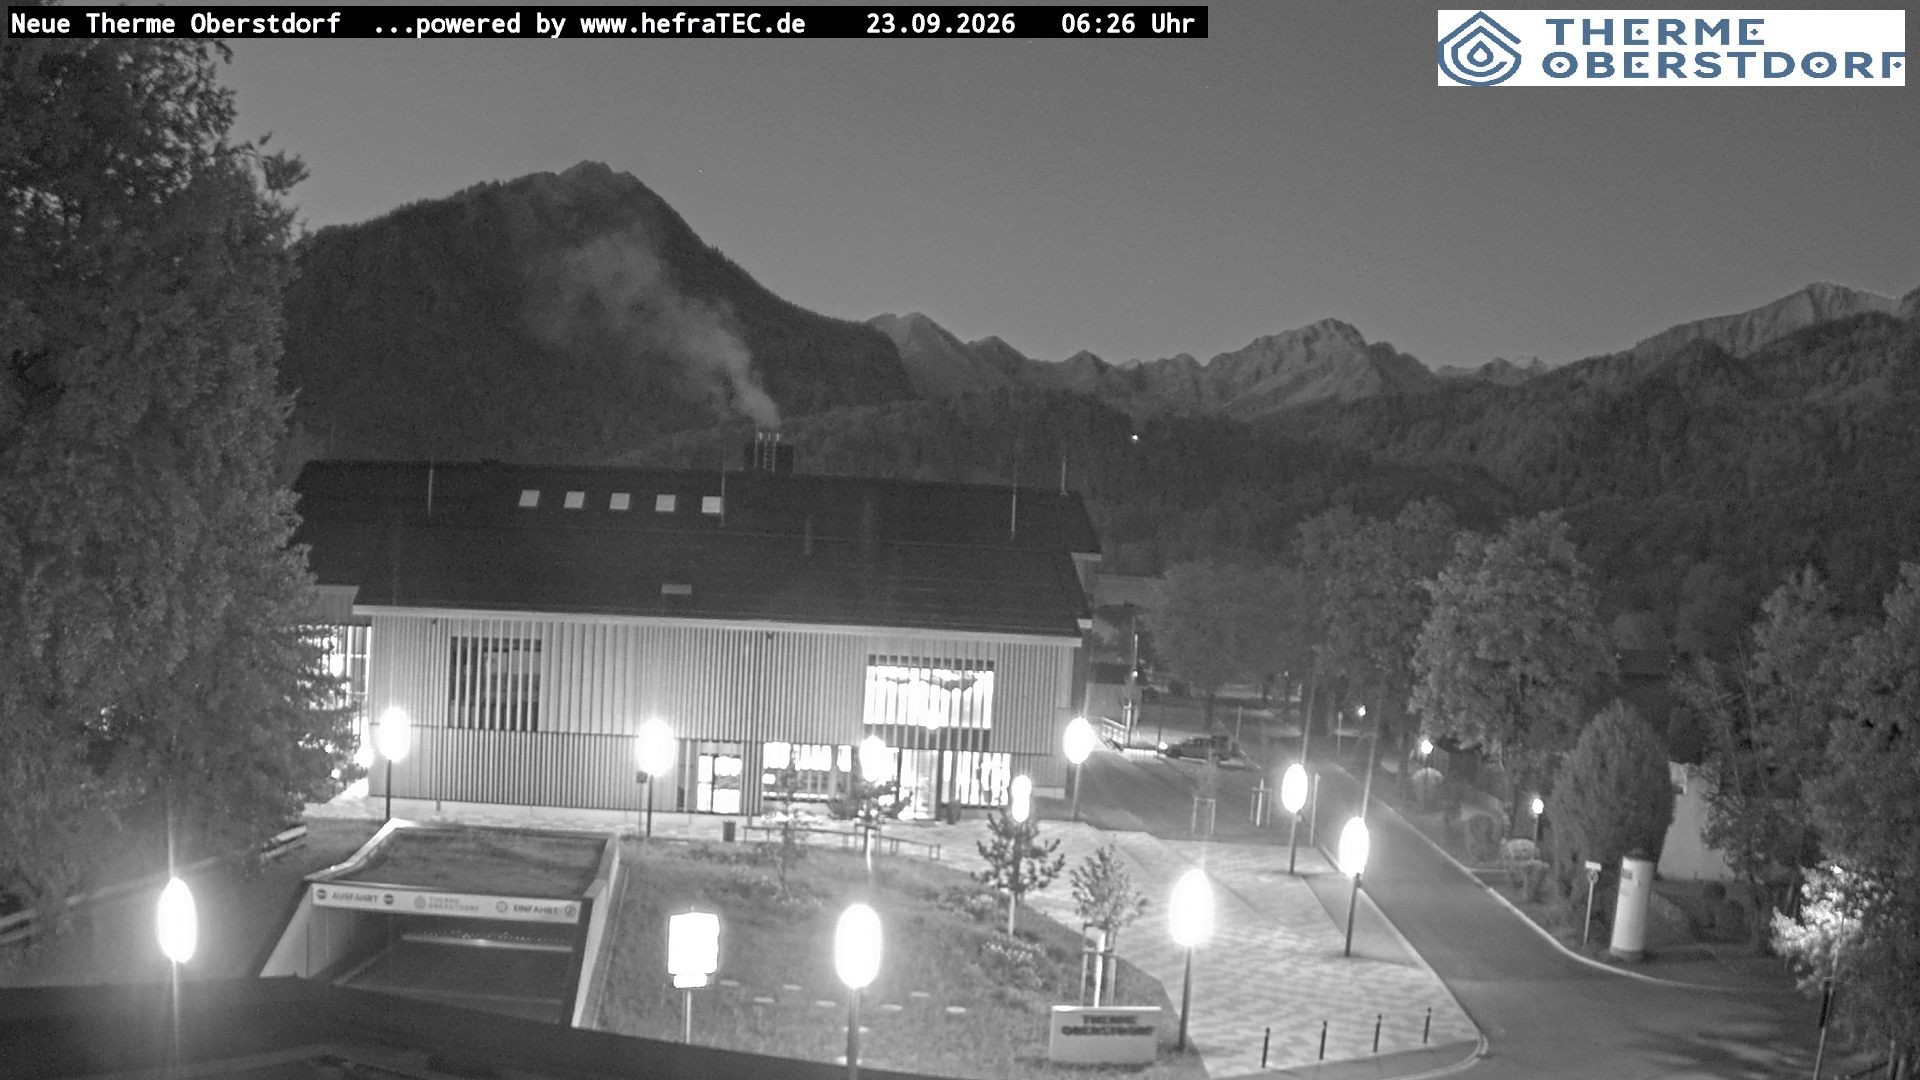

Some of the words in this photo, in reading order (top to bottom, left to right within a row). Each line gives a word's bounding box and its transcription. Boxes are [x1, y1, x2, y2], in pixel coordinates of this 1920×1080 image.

[332, 891, 378, 902] AUSFAHRT
[513, 903, 558, 915] EINFAHRT
[1083, 1015, 1136, 1025] THERME
[1061, 1025, 1155, 1036] OBERSTDORF
